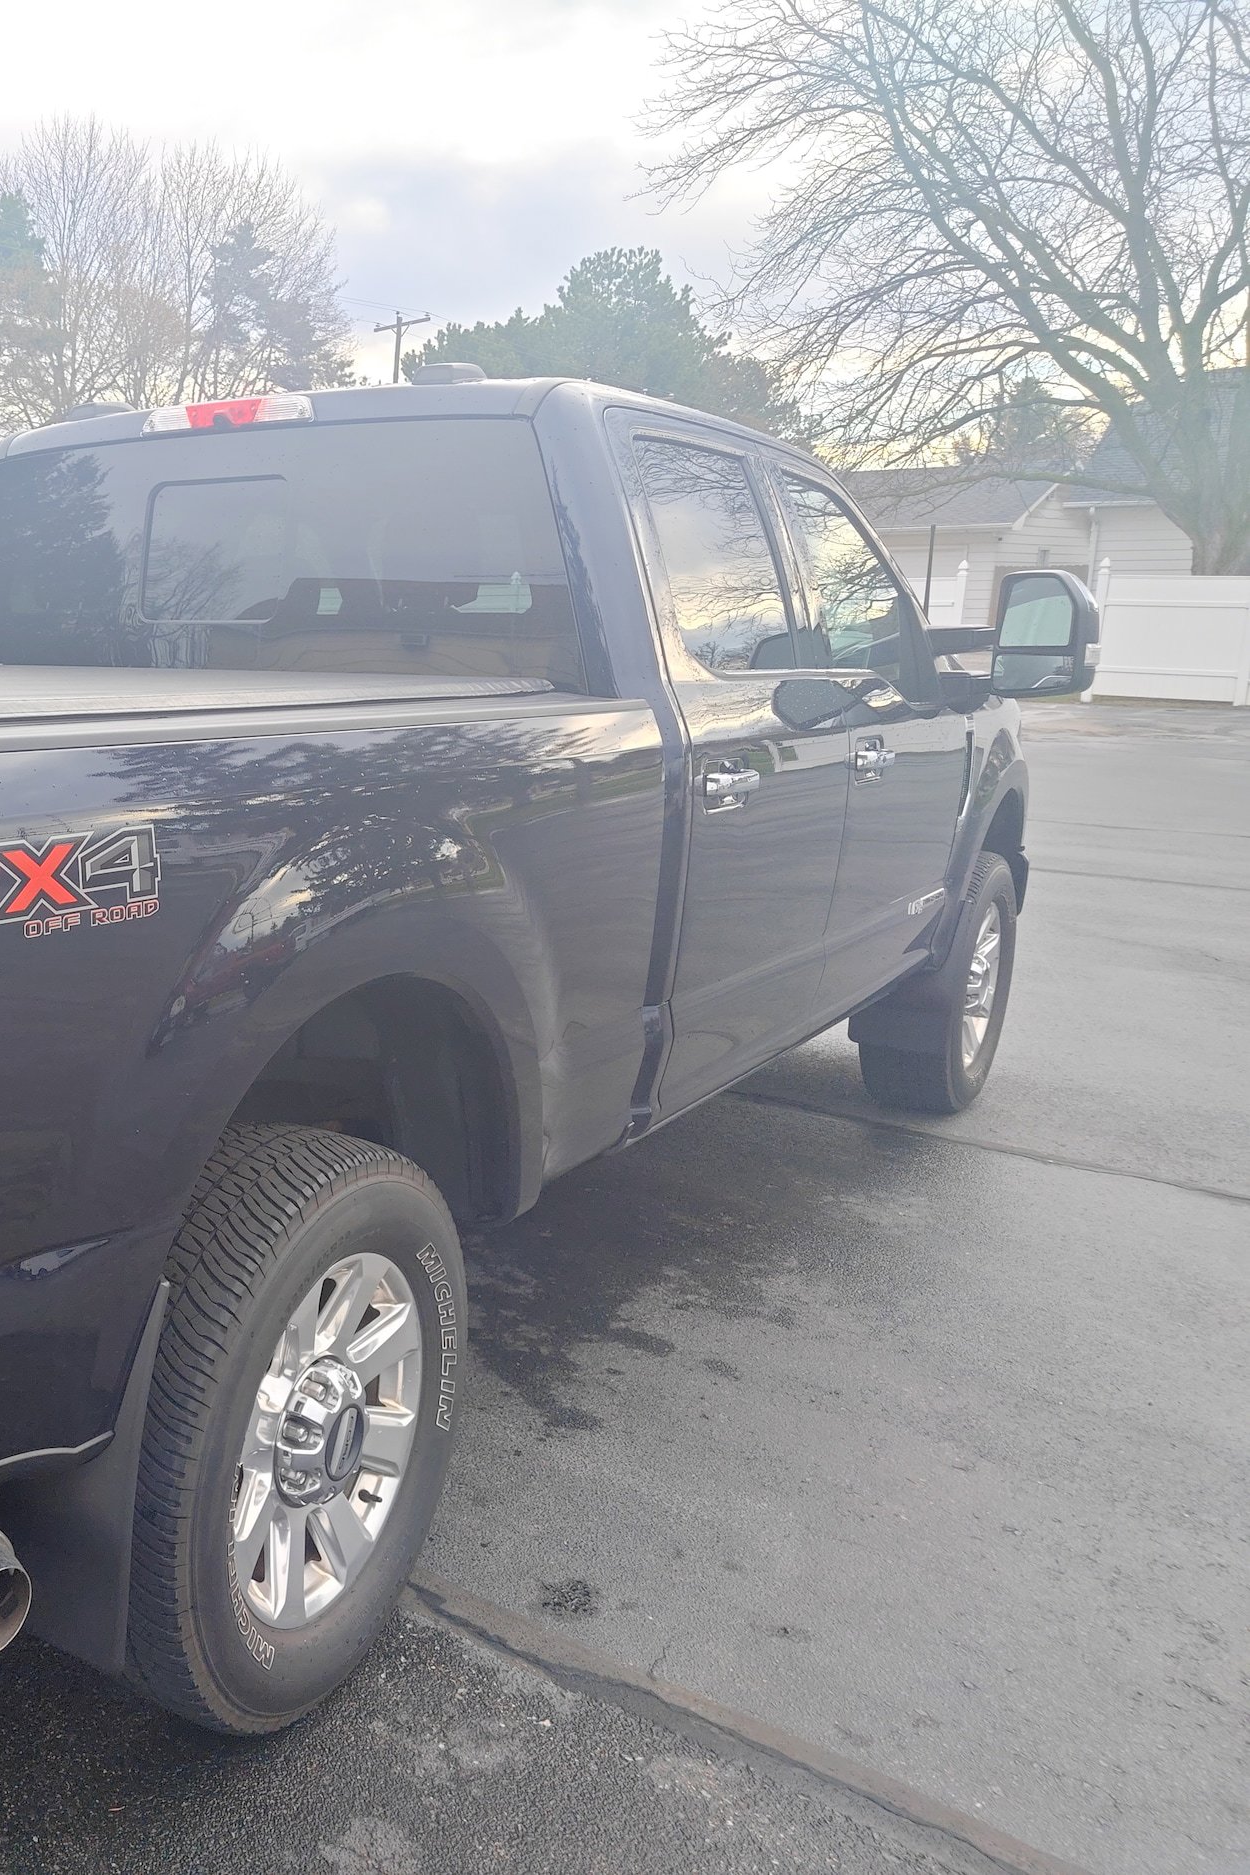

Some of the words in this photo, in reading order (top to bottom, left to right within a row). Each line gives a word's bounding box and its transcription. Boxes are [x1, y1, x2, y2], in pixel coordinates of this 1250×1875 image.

[23, 911, 81, 939] OFF
[90, 899, 160, 927] ROAD
[415, 1242, 458, 1432] MICHELIN
